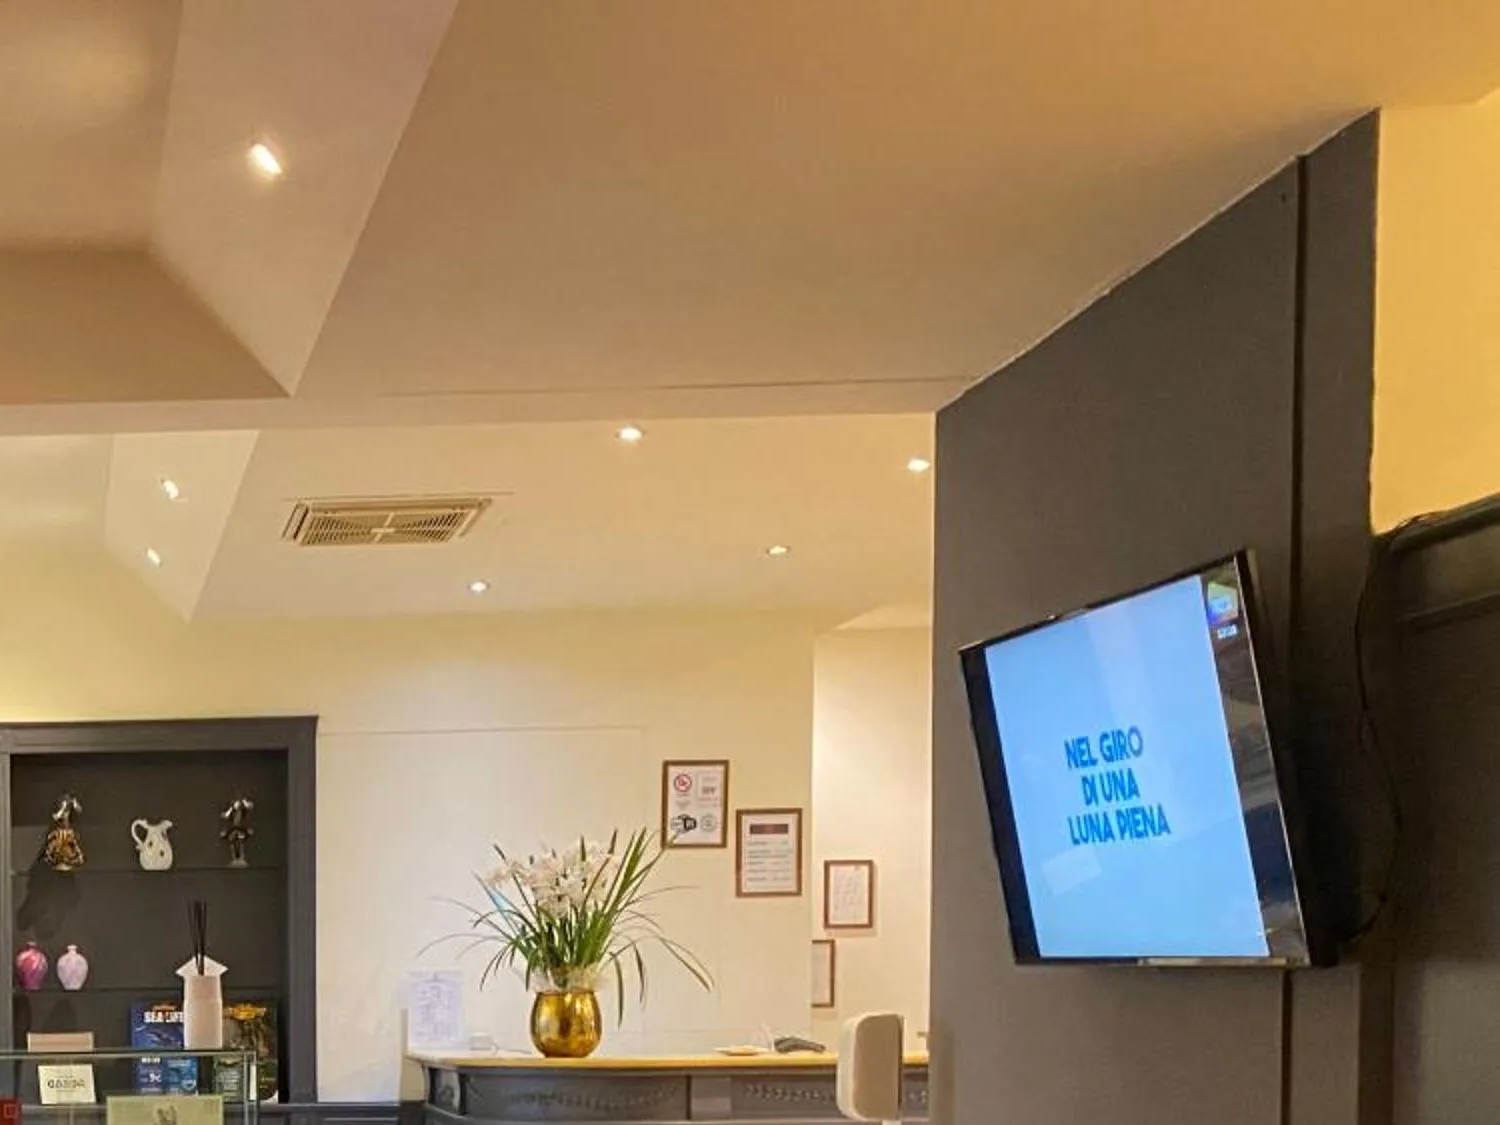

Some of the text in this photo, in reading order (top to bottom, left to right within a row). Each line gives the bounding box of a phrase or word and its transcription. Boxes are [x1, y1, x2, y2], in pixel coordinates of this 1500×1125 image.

[1064, 726, 1143, 769] NEL GIRO
[1082, 768, 1140, 806] DI UNA
[1067, 803, 1171, 845] LUNA PIENA
